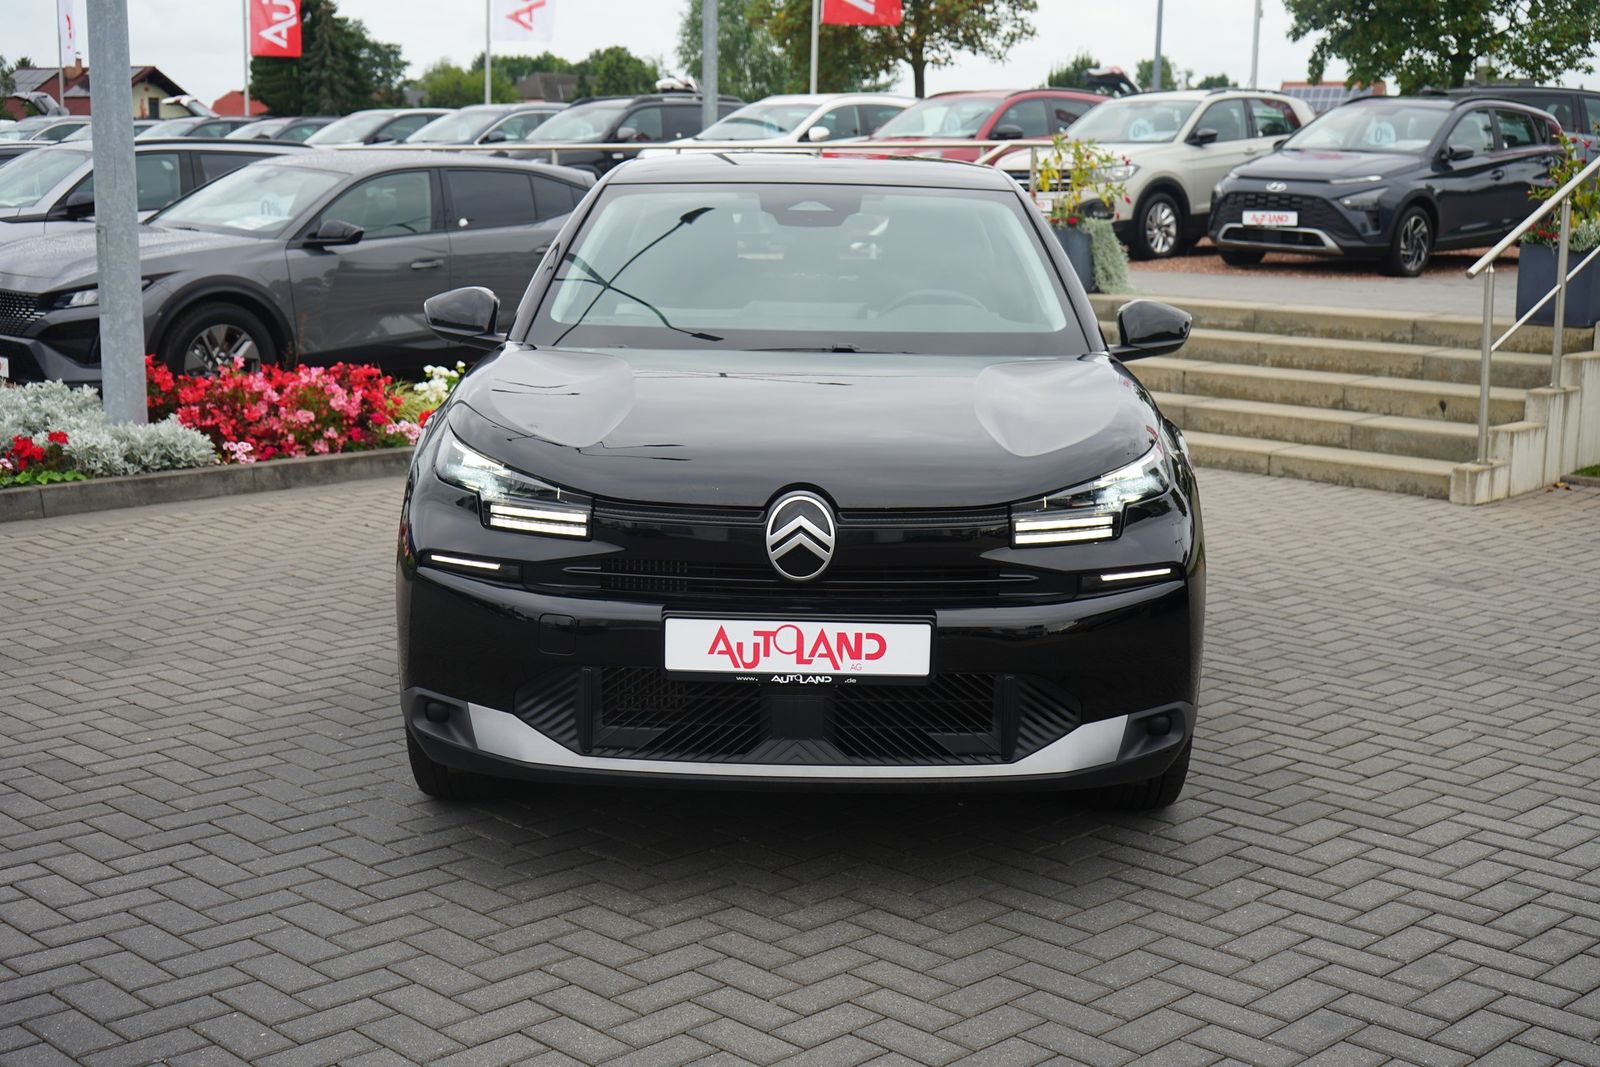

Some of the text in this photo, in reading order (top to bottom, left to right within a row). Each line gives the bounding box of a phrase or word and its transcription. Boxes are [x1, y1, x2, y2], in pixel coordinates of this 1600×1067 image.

[258, 0, 297, 49] AU
[708, 624, 887, 671] AUTOLAND
[770, 673, 832, 685] AUTOLAND
[849, 663, 863, 672] AG
